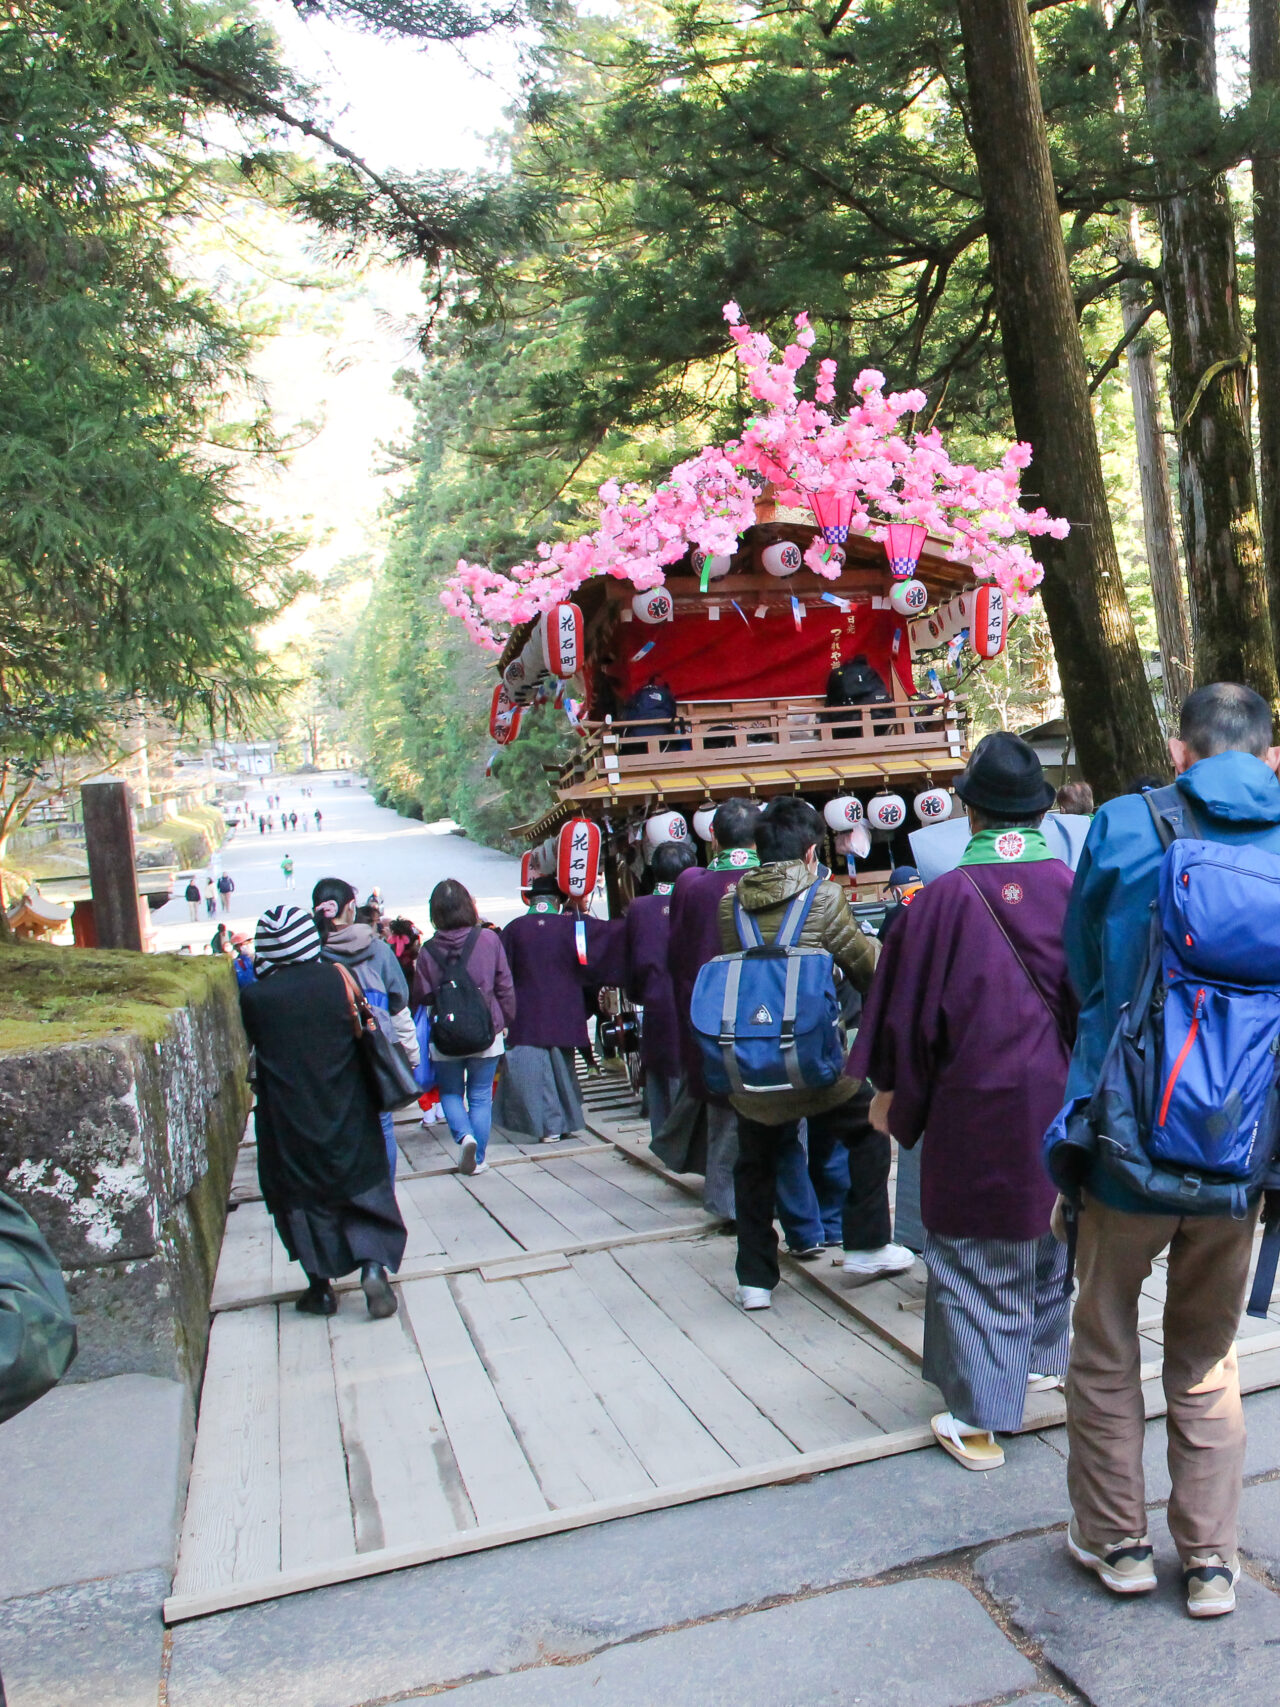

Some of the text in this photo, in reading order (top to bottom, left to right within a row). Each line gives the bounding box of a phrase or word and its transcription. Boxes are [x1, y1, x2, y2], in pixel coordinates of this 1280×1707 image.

[784, 547, 799, 566] 花
[909, 588, 925, 606] 花
[651, 598, 669, 617] 花
[987, 595, 1004, 644] 花石町
[560, 614, 576, 666] 花石町
[848, 803, 861, 821] 花
[882, 807, 899, 823] 花
[924, 797, 941, 815] 花
[672, 819, 686, 837] 花
[569, 832, 588, 888] 花石町
